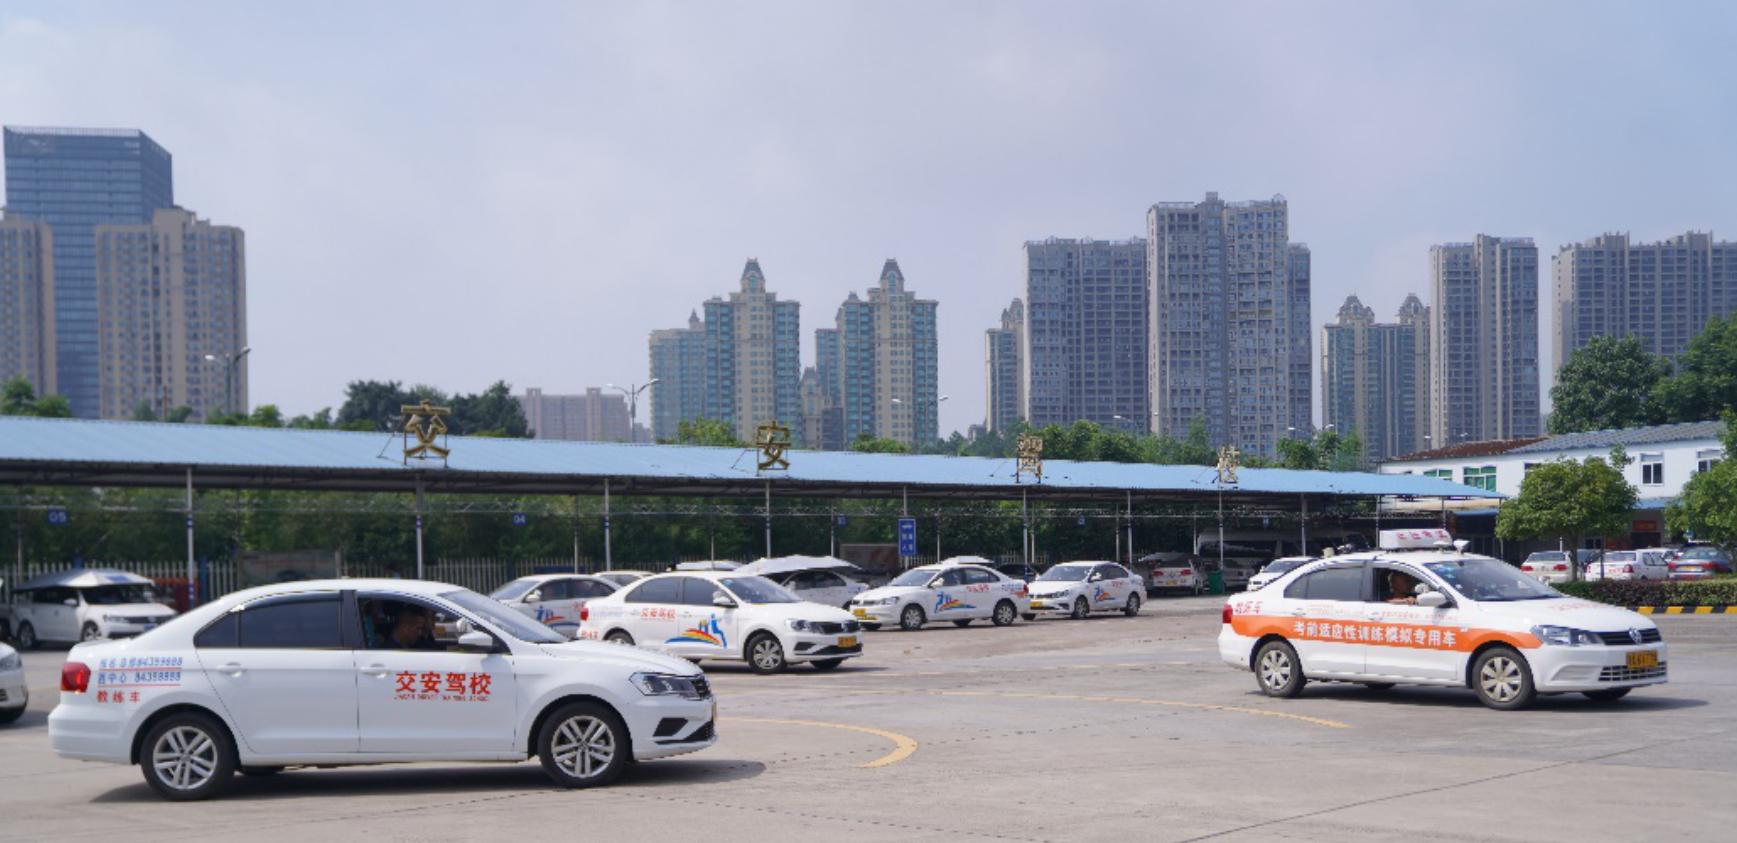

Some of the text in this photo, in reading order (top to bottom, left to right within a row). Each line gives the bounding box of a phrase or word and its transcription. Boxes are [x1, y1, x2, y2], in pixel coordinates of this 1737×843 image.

[401, 399, 452, 457] 交
[756, 420, 791, 470] 安
[1293, 621, 1457, 647] 考前适应性训练模拟专用车
[394, 670, 492, 695] 交安驾校
[97, 690, 141, 703] 教练车
